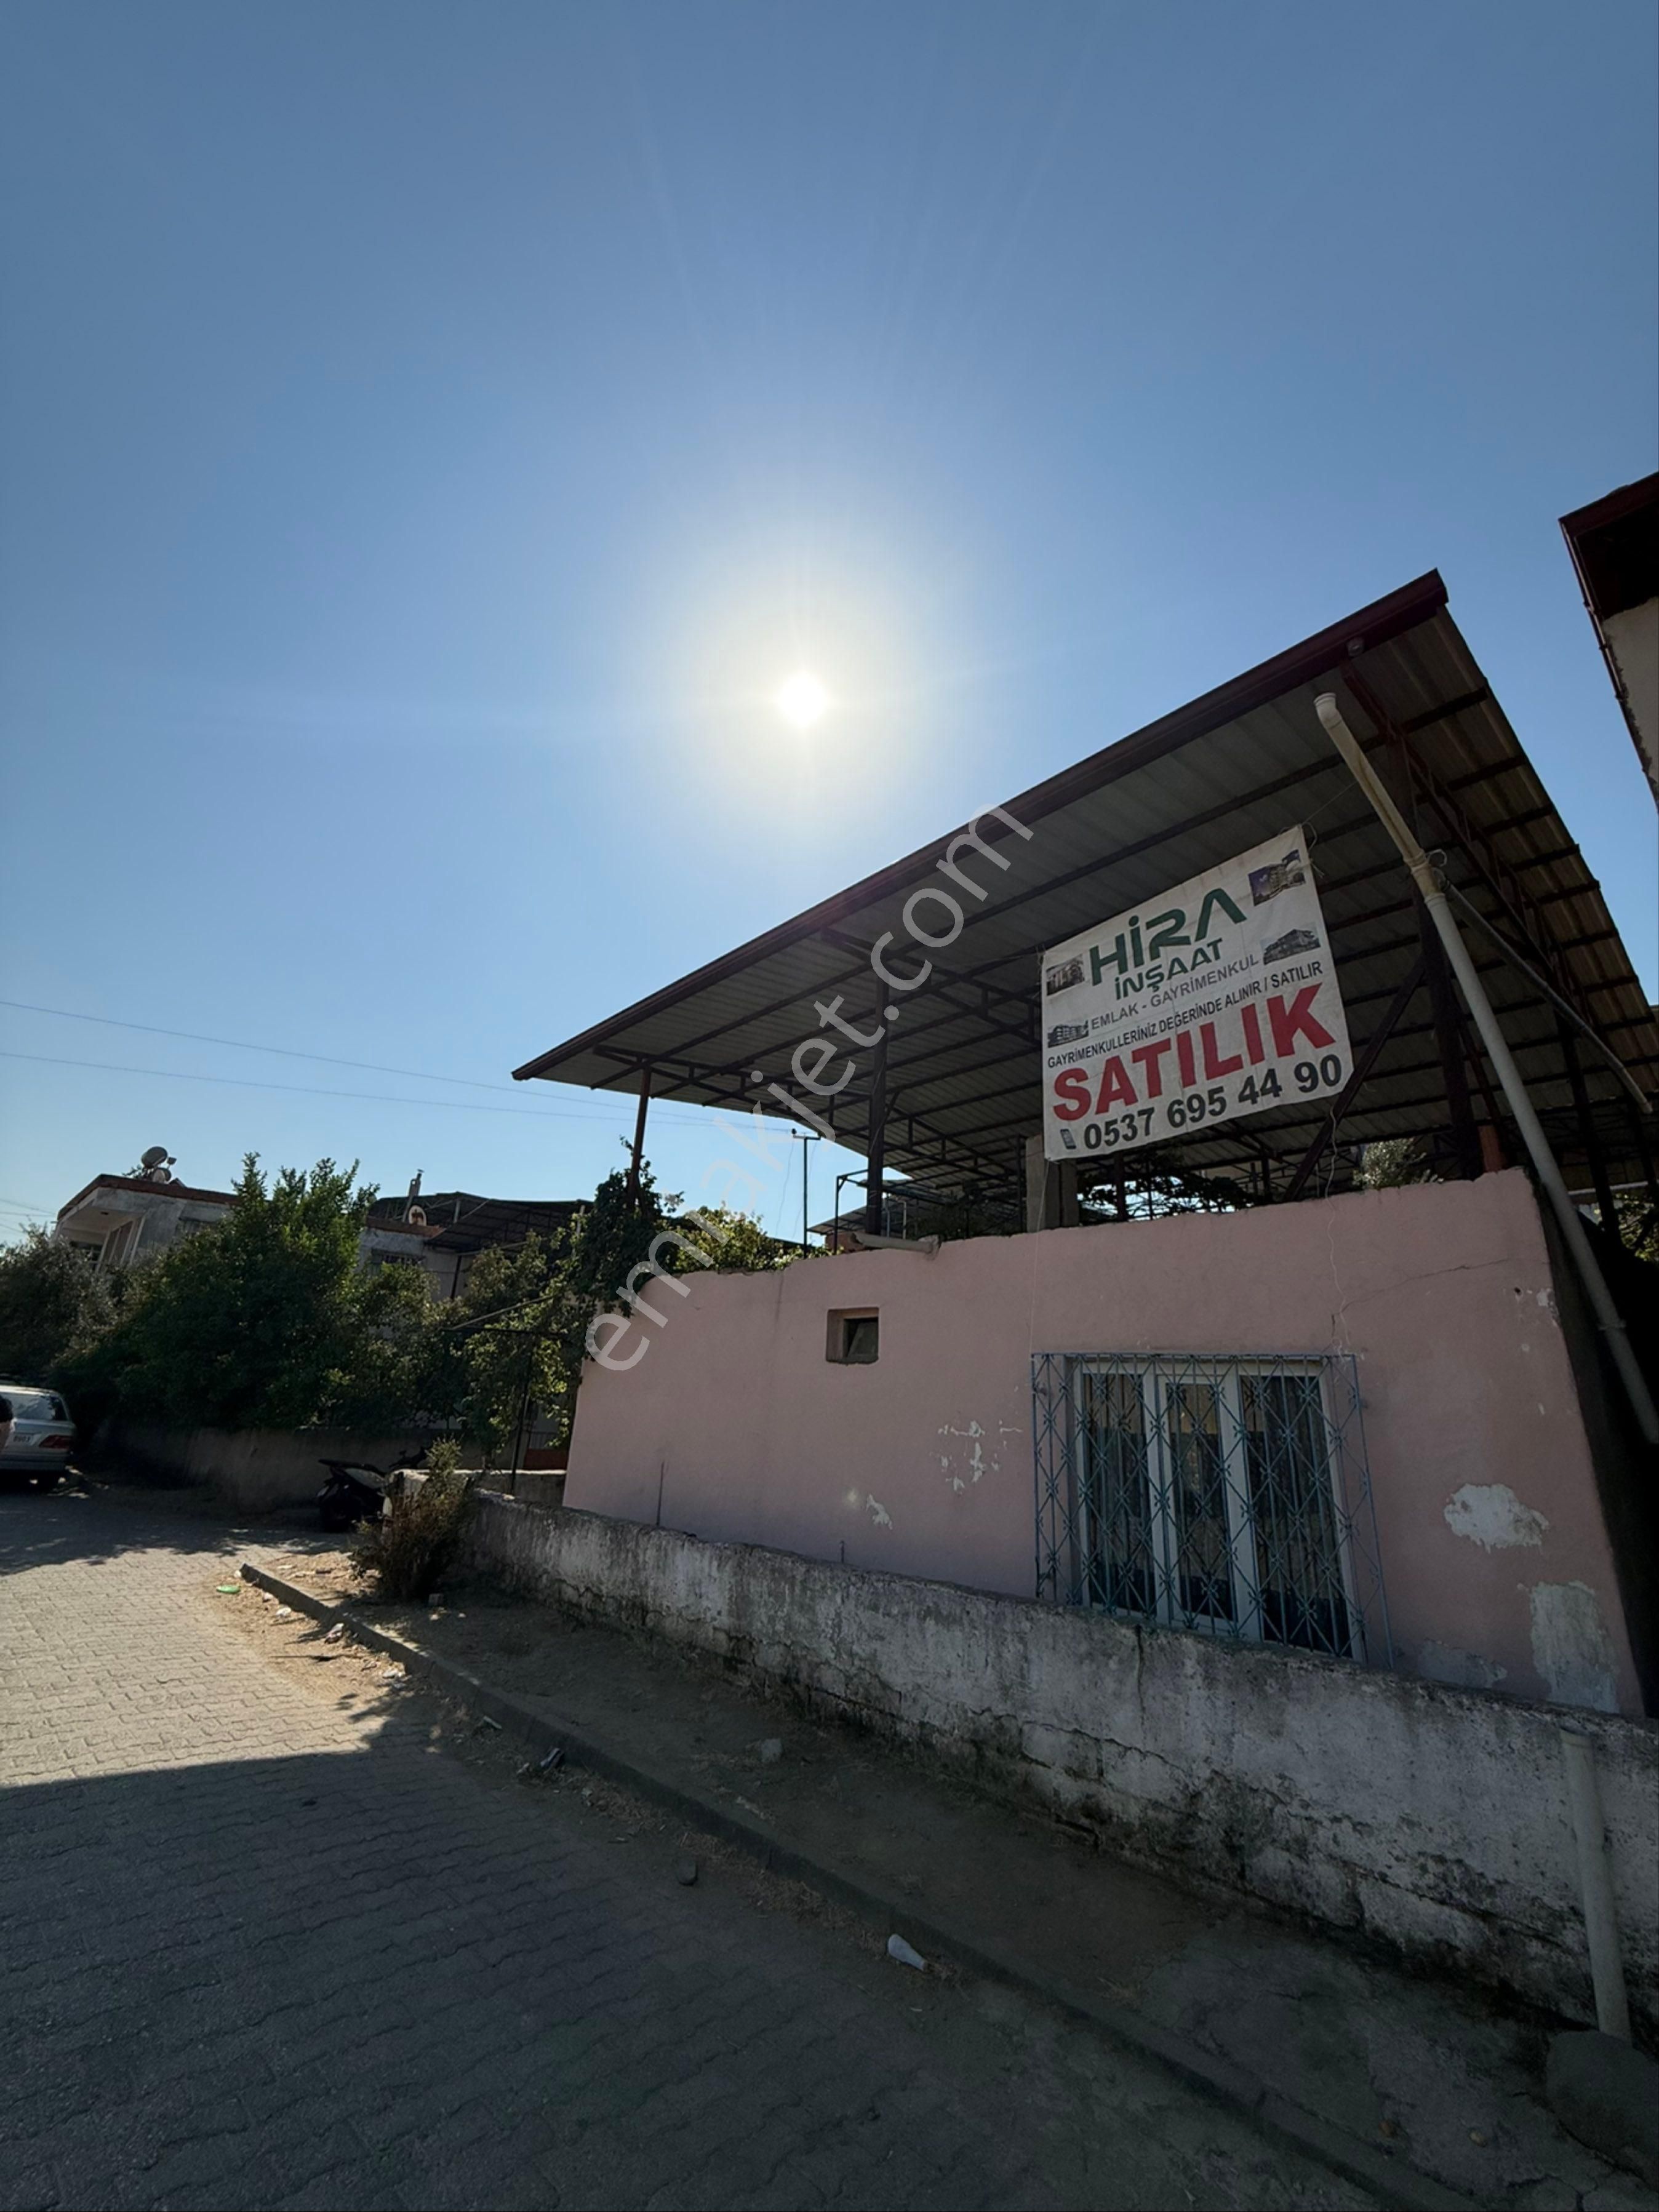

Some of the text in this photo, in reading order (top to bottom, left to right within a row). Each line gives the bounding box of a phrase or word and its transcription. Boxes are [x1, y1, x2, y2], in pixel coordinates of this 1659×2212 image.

[1090, 888, 1247, 986] HİRA
[1114, 938, 1223, 1000] İNŞAAT
[1047, 961, 1323, 1068] GAYRİMENKULLERİNİZ DEĞERİNDE ALINIR / SATILIR
[1091, 1002, 1139, 1030] EMLAK
[1151, 954, 1259, 1008] GAYRİMENKUL
[1053, 982, 1336, 1121] SATILIK
[1083, 1054, 1342, 1149] 0537 695 44 90
